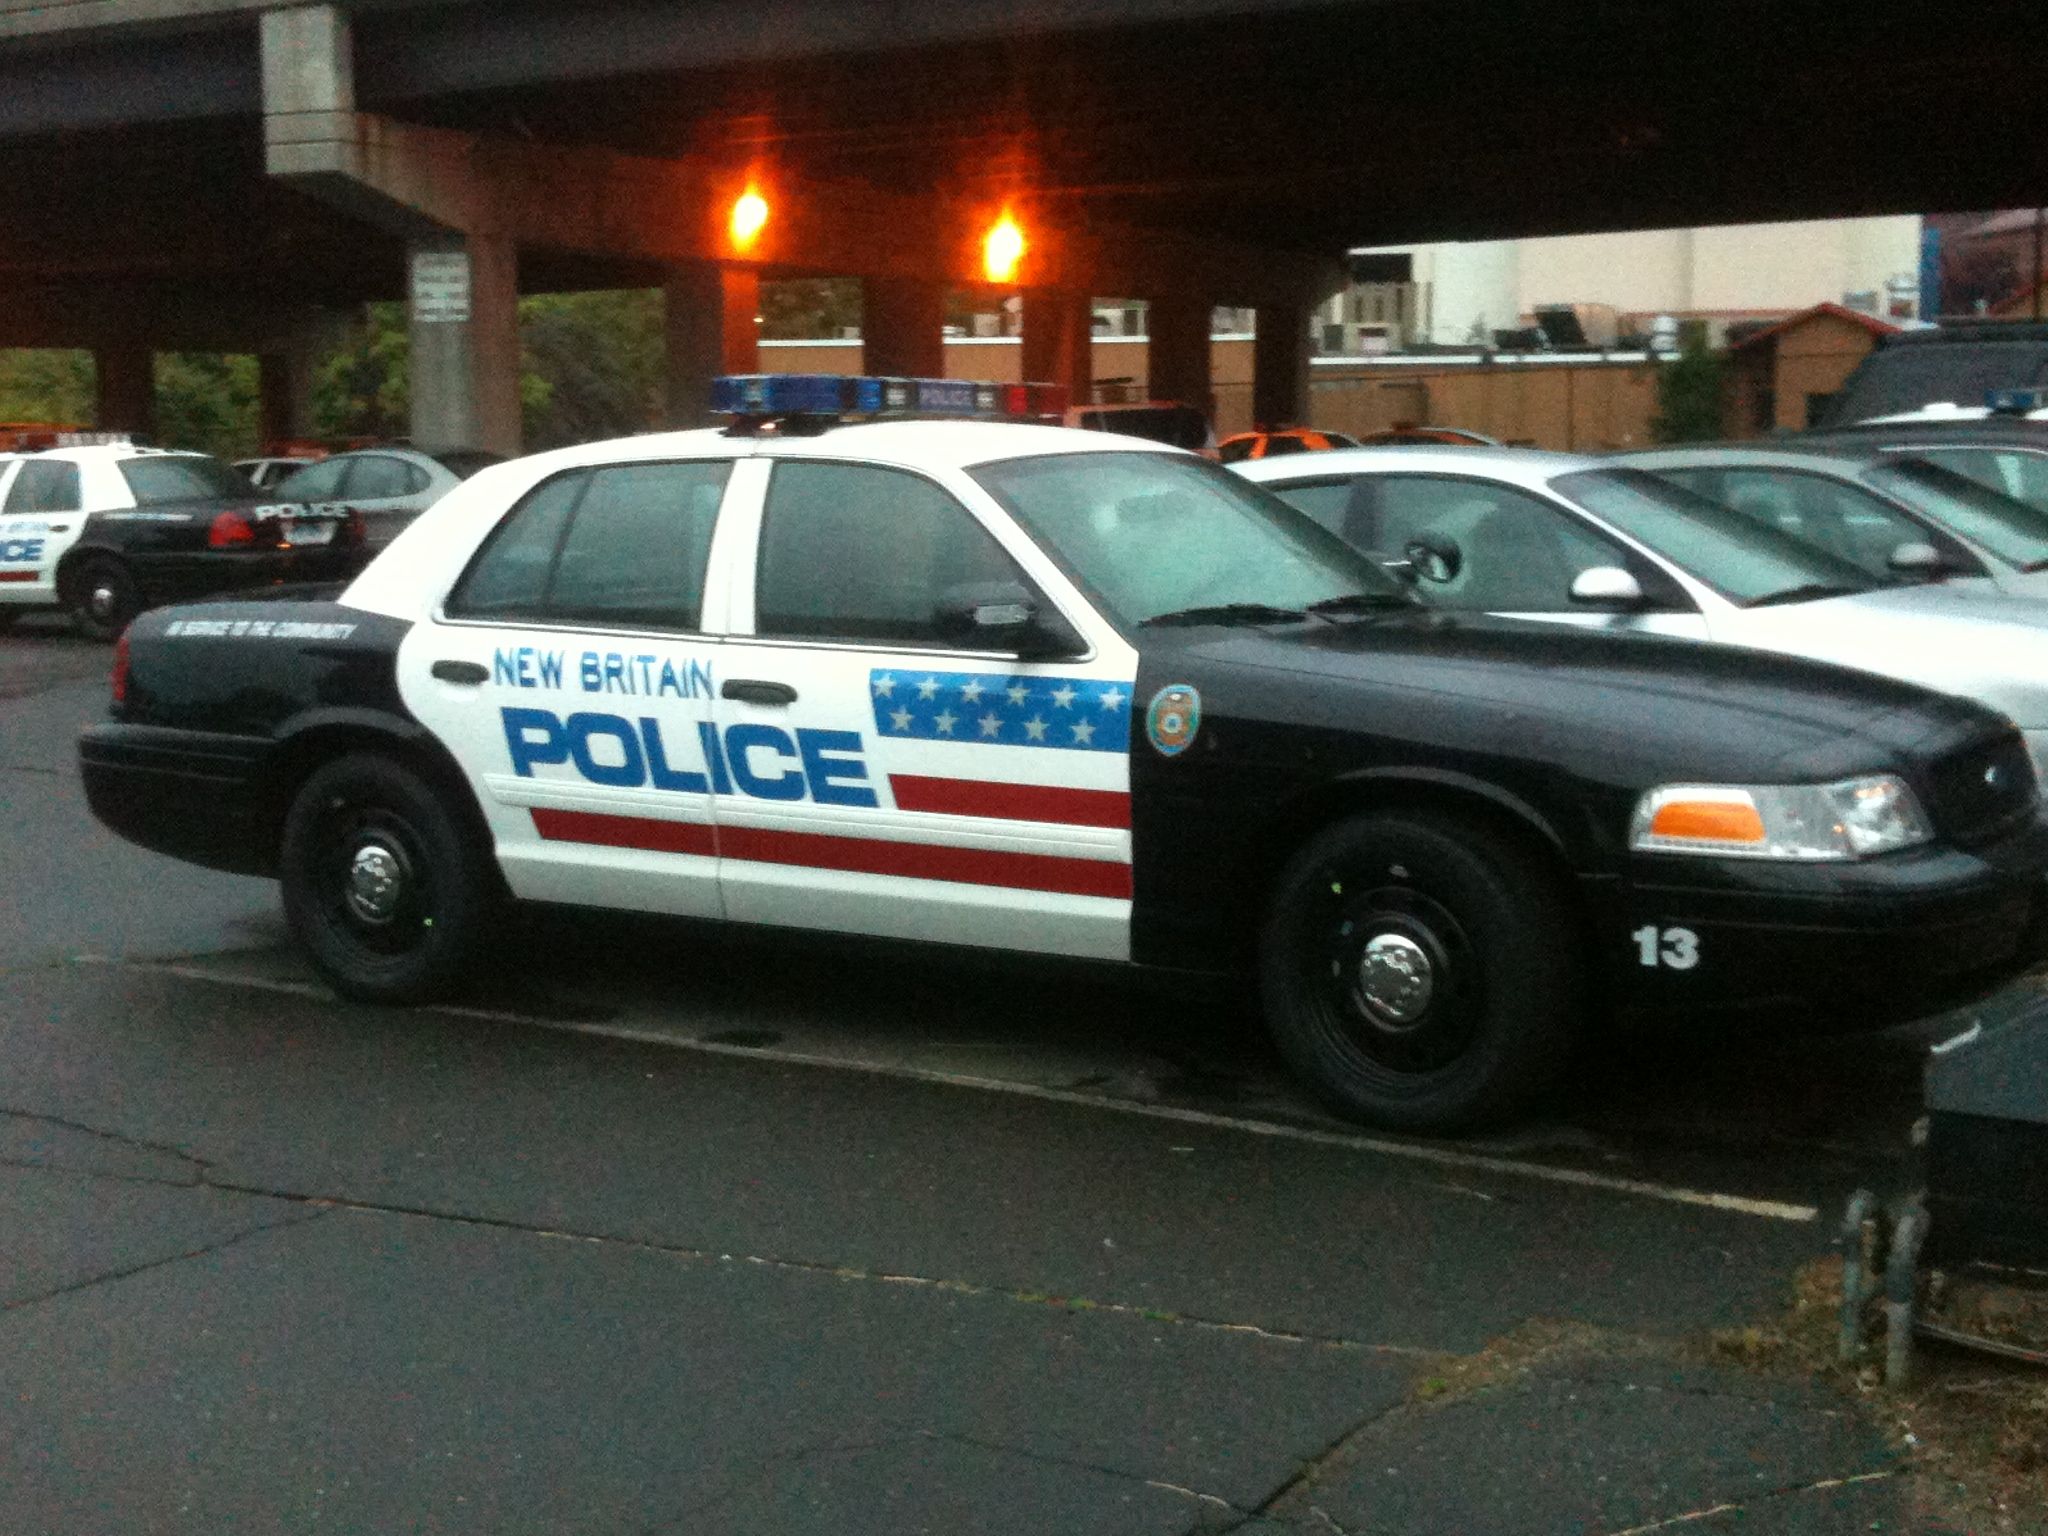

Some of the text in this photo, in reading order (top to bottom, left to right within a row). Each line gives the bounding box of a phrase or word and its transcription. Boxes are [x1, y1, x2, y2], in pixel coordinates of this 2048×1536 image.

[255, 503, 350, 521] POLICE
[0, 539, 45, 561] CE
[494, 647, 715, 700] NEW BRITAIN
[500, 706, 881, 808] POLICE
[1631, 925, 1700, 970] 13
